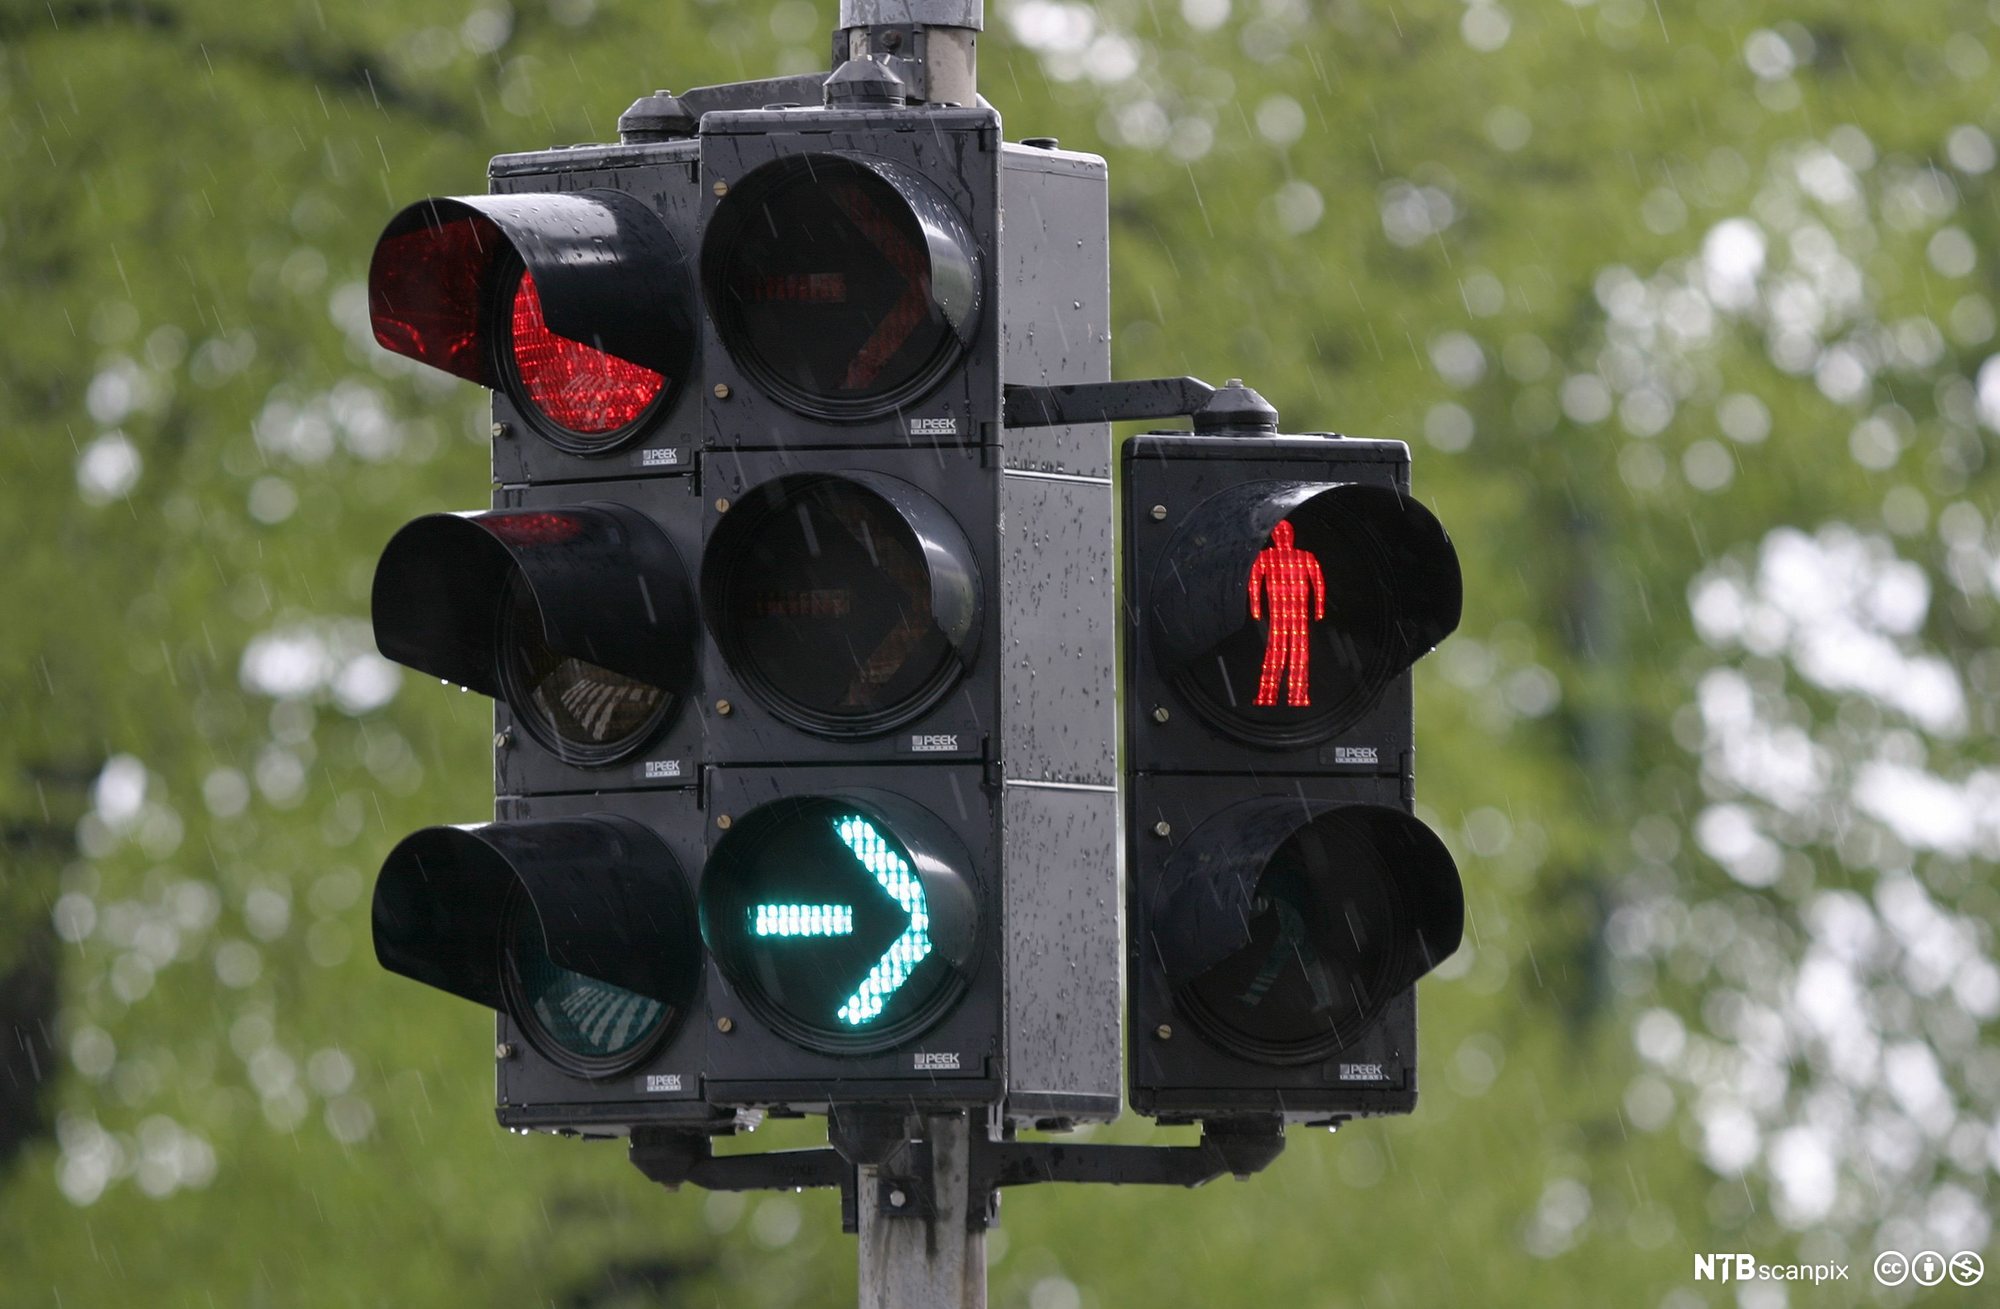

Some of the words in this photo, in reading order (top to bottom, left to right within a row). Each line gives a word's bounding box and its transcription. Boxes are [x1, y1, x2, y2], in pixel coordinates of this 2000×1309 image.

[923, 418, 956, 429] PEEK
[652, 448, 677, 460] PEEK
[924, 734, 957, 745] PEEK
[1346, 747, 1378, 758] PEEK
[654, 760, 680, 771] PEEK
[926, 1053, 959, 1064] PEEK
[1351, 1063, 1383, 1075] PEEK
[656, 1074, 681, 1086] PEEK
